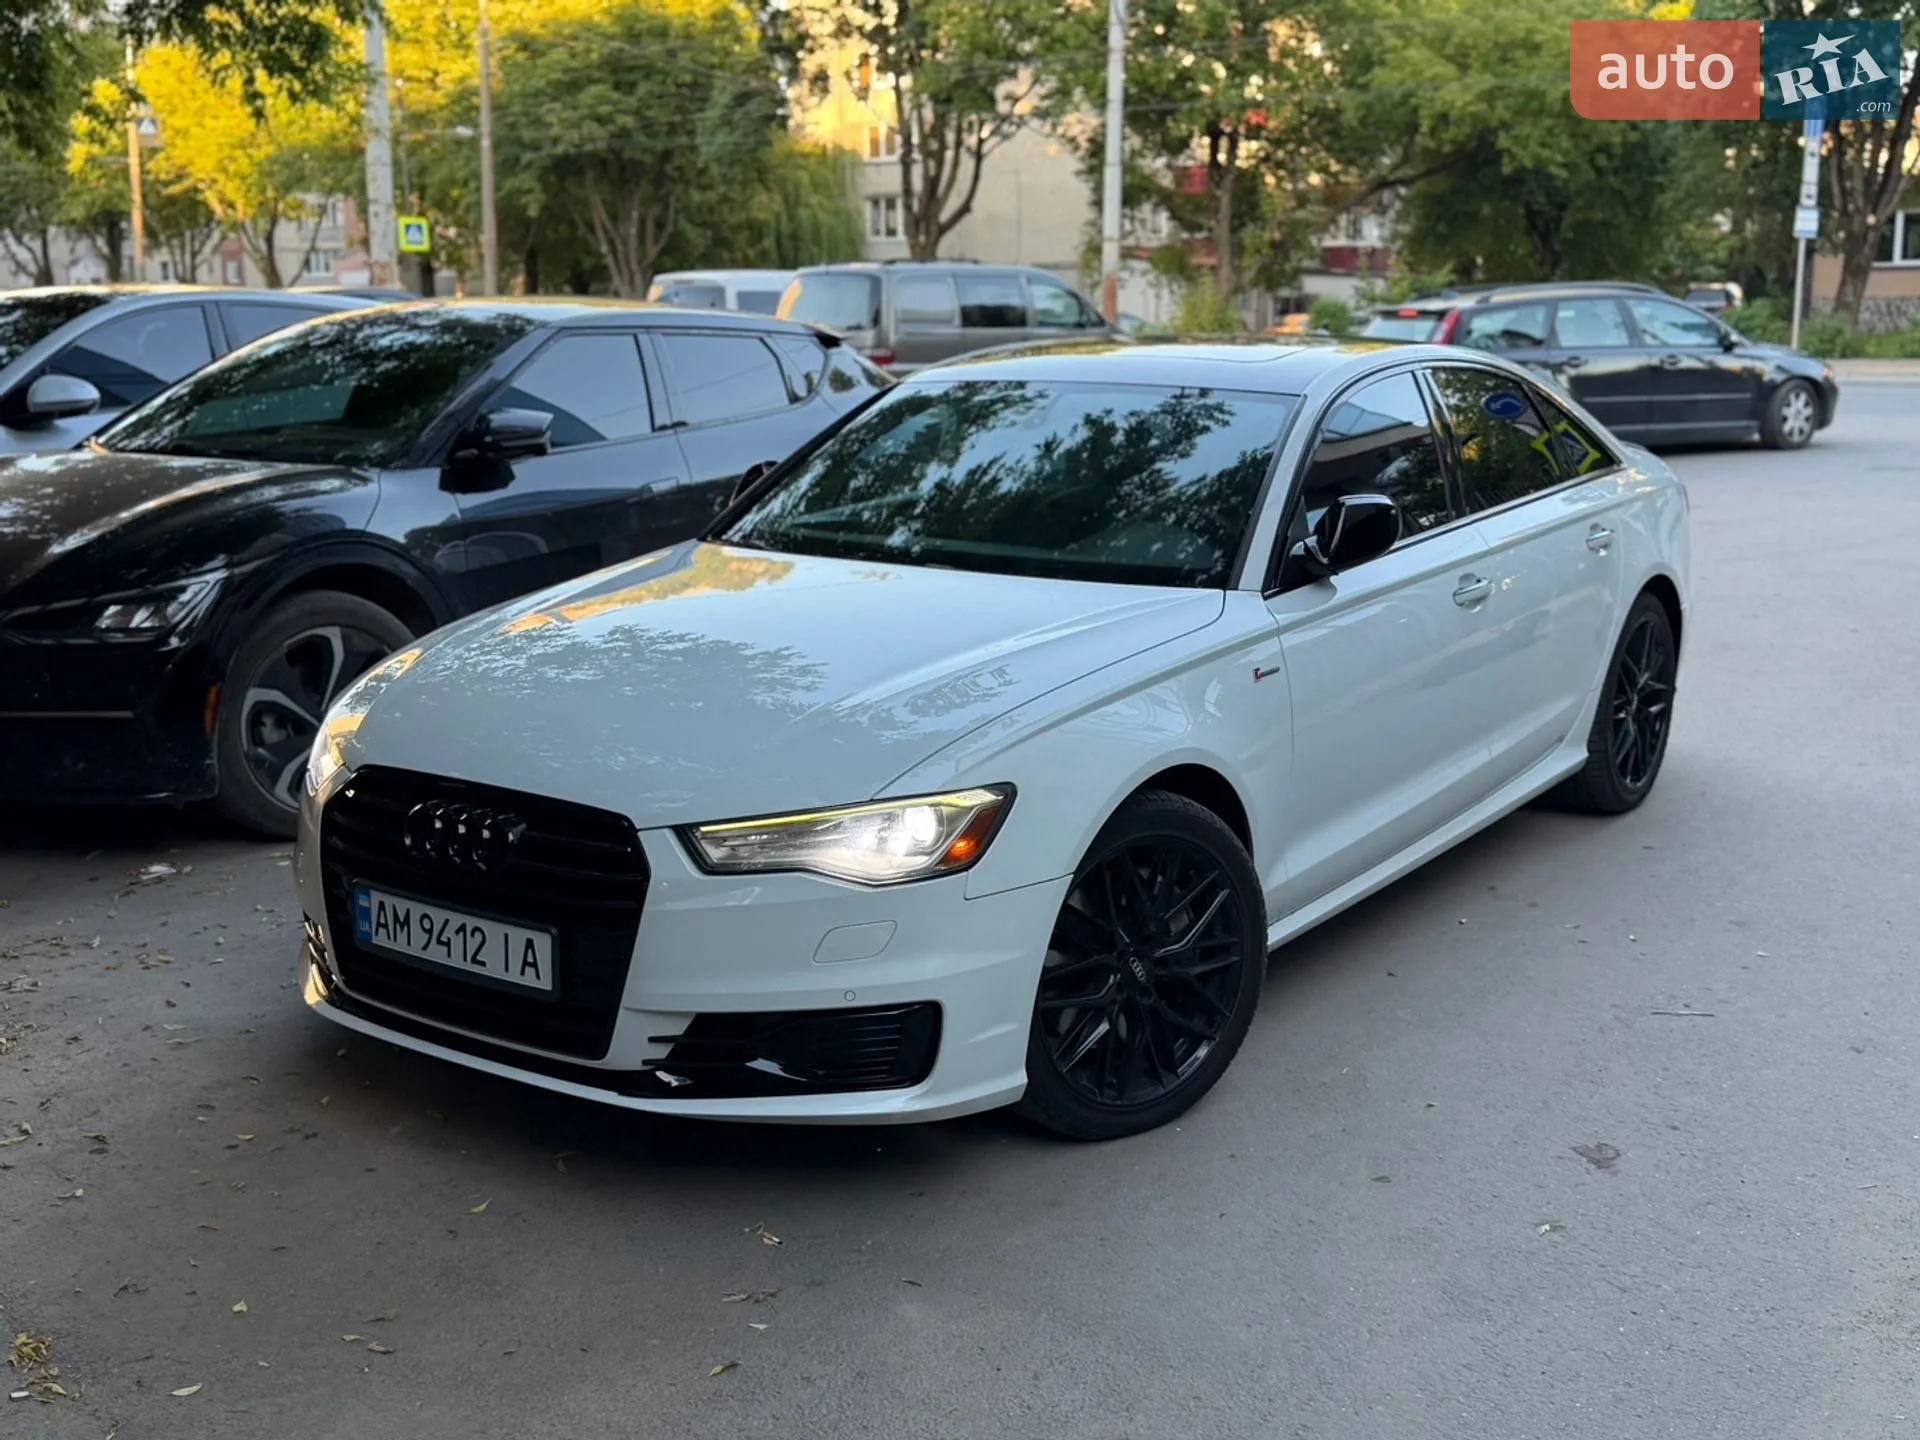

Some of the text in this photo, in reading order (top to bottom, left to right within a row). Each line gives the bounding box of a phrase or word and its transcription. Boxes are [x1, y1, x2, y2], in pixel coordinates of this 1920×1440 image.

[375, 900, 542, 981] AM 9412 IA
